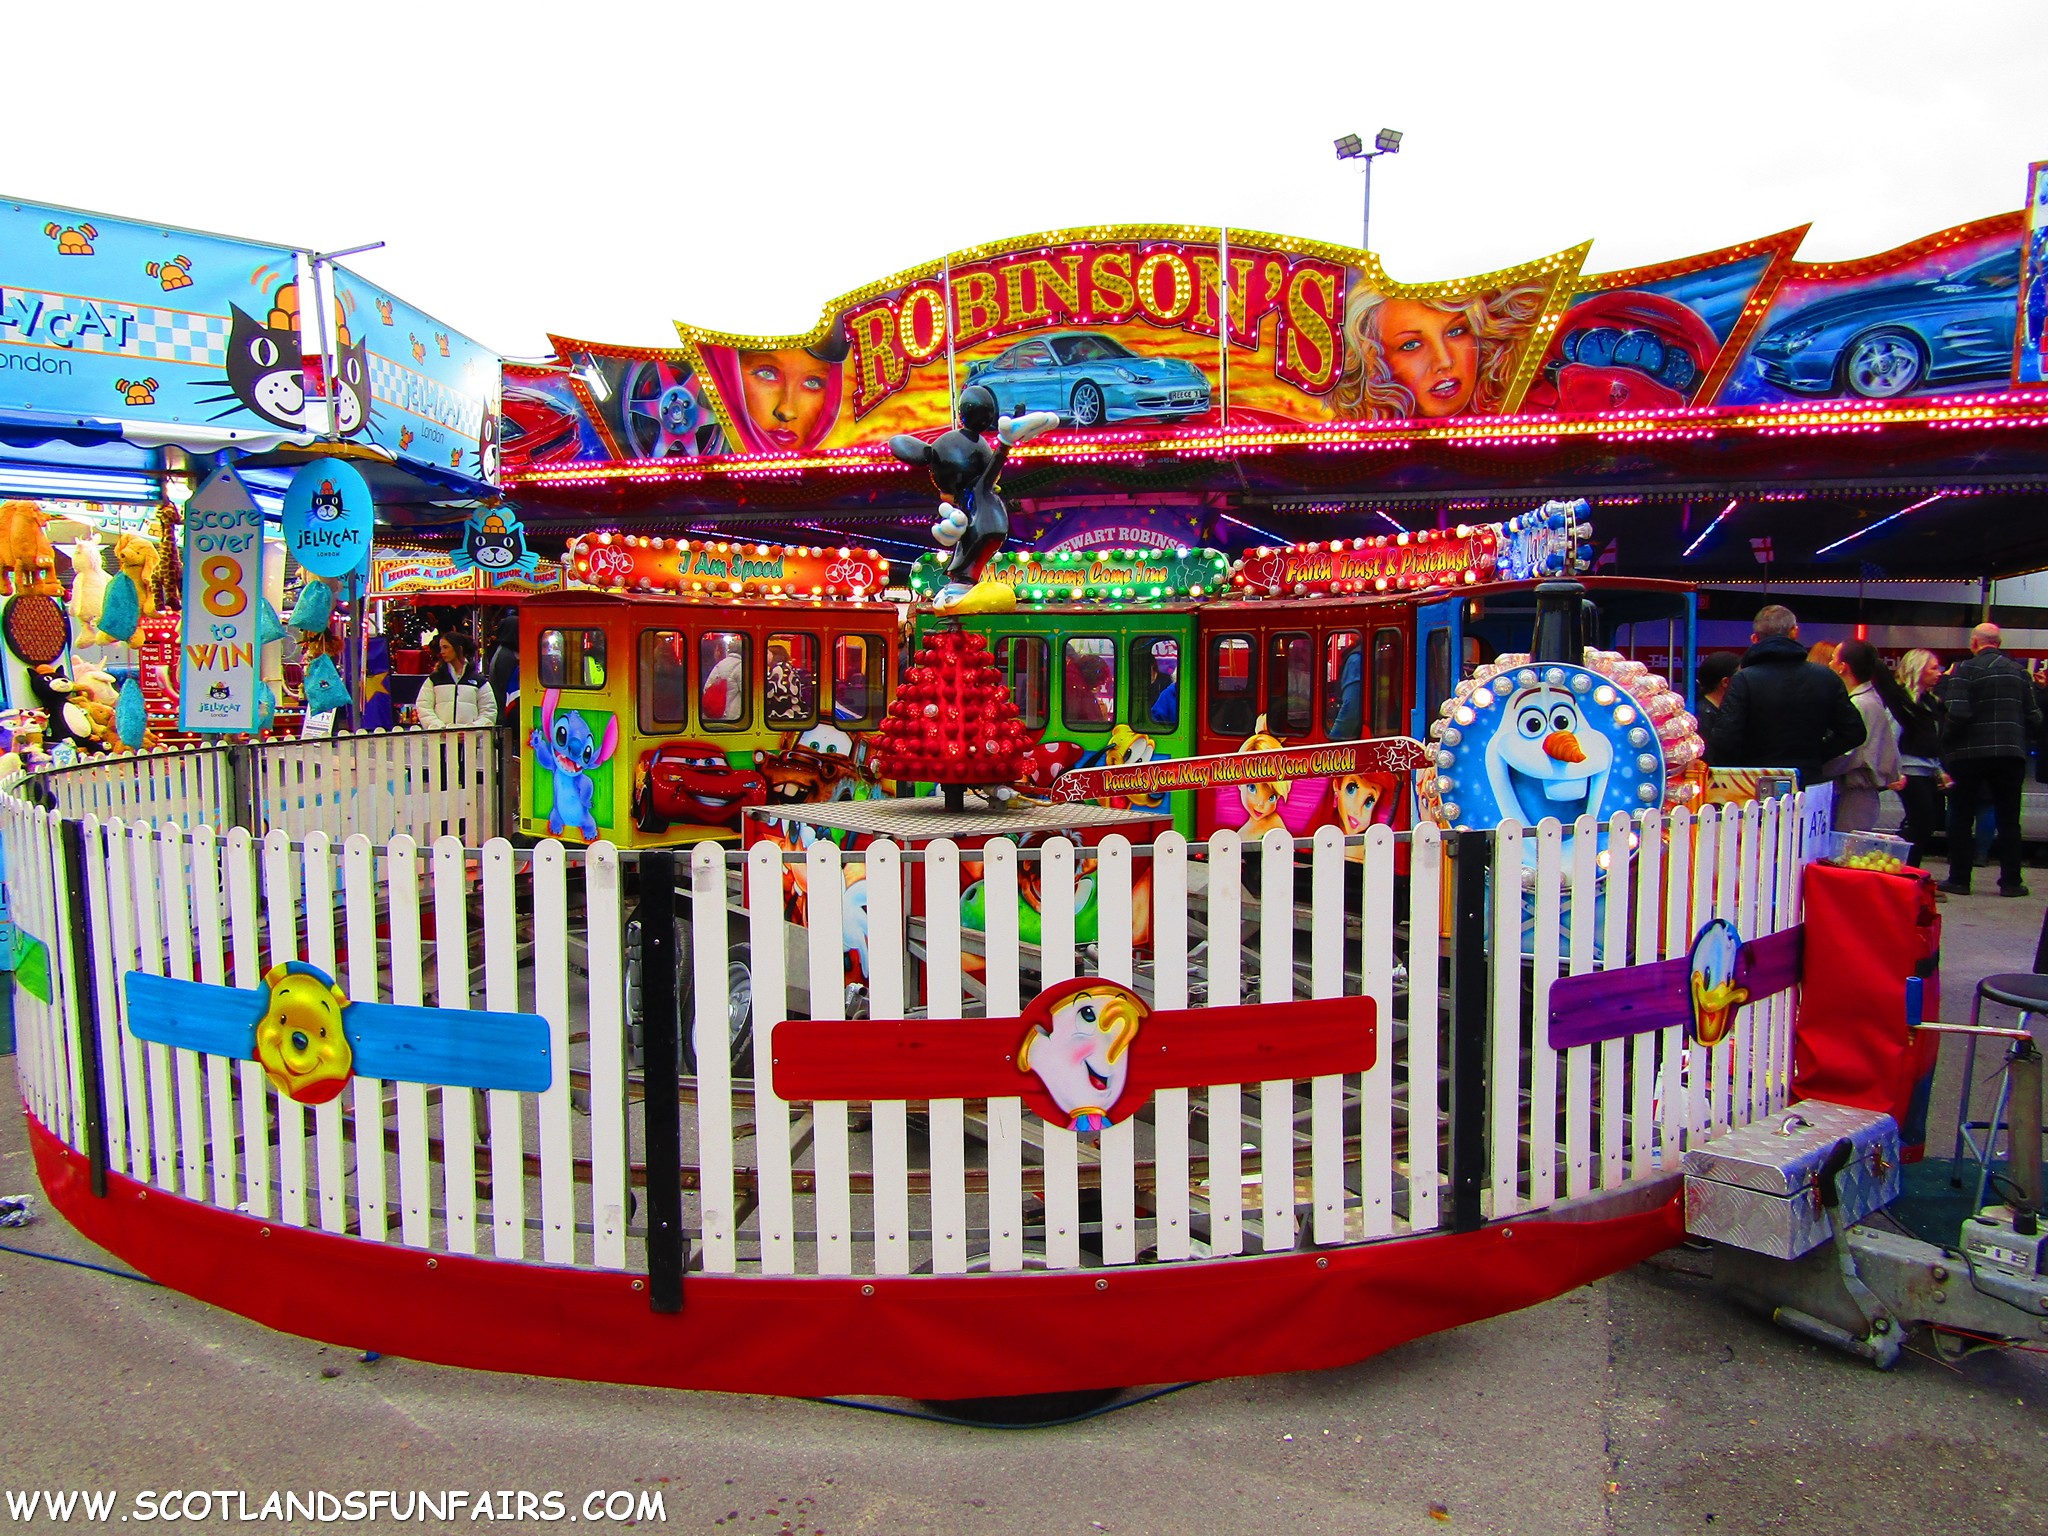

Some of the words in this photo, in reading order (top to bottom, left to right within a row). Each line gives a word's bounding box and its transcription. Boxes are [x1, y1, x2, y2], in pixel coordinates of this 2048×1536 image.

[852, 253, 1334, 405] ROBINSON'S
[421, 421, 445, 444] London
[1052, 528, 1117, 553] TEWART
[424, 569, 433, 578] A
[436, 567, 469, 578] DUC
[533, 571, 557, 583] DUCK
[694, 552, 726, 578] Am
[730, 554, 784, 582] Speed
[1027, 561, 1086, 586] Dreams
[1089, 561, 1132, 586] Come
[1135, 559, 1168, 583] True
[1286, 554, 1332, 583] Faith
[1340, 551, 1381, 579] Trust
[1401, 543, 1470, 574] Pixiedust
[201, 555, 248, 617] 8
[186, 642, 253, 671] WIN
[1103, 771, 1150, 791] Parents
[1150, 767, 1175, 790] You
[1178, 763, 1210, 787] May
[1212, 758, 1242, 782] Ride
[1242, 754, 1276, 778] With
[1277, 756, 1308, 781] Your
[1311, 749, 1356, 773] Child!
